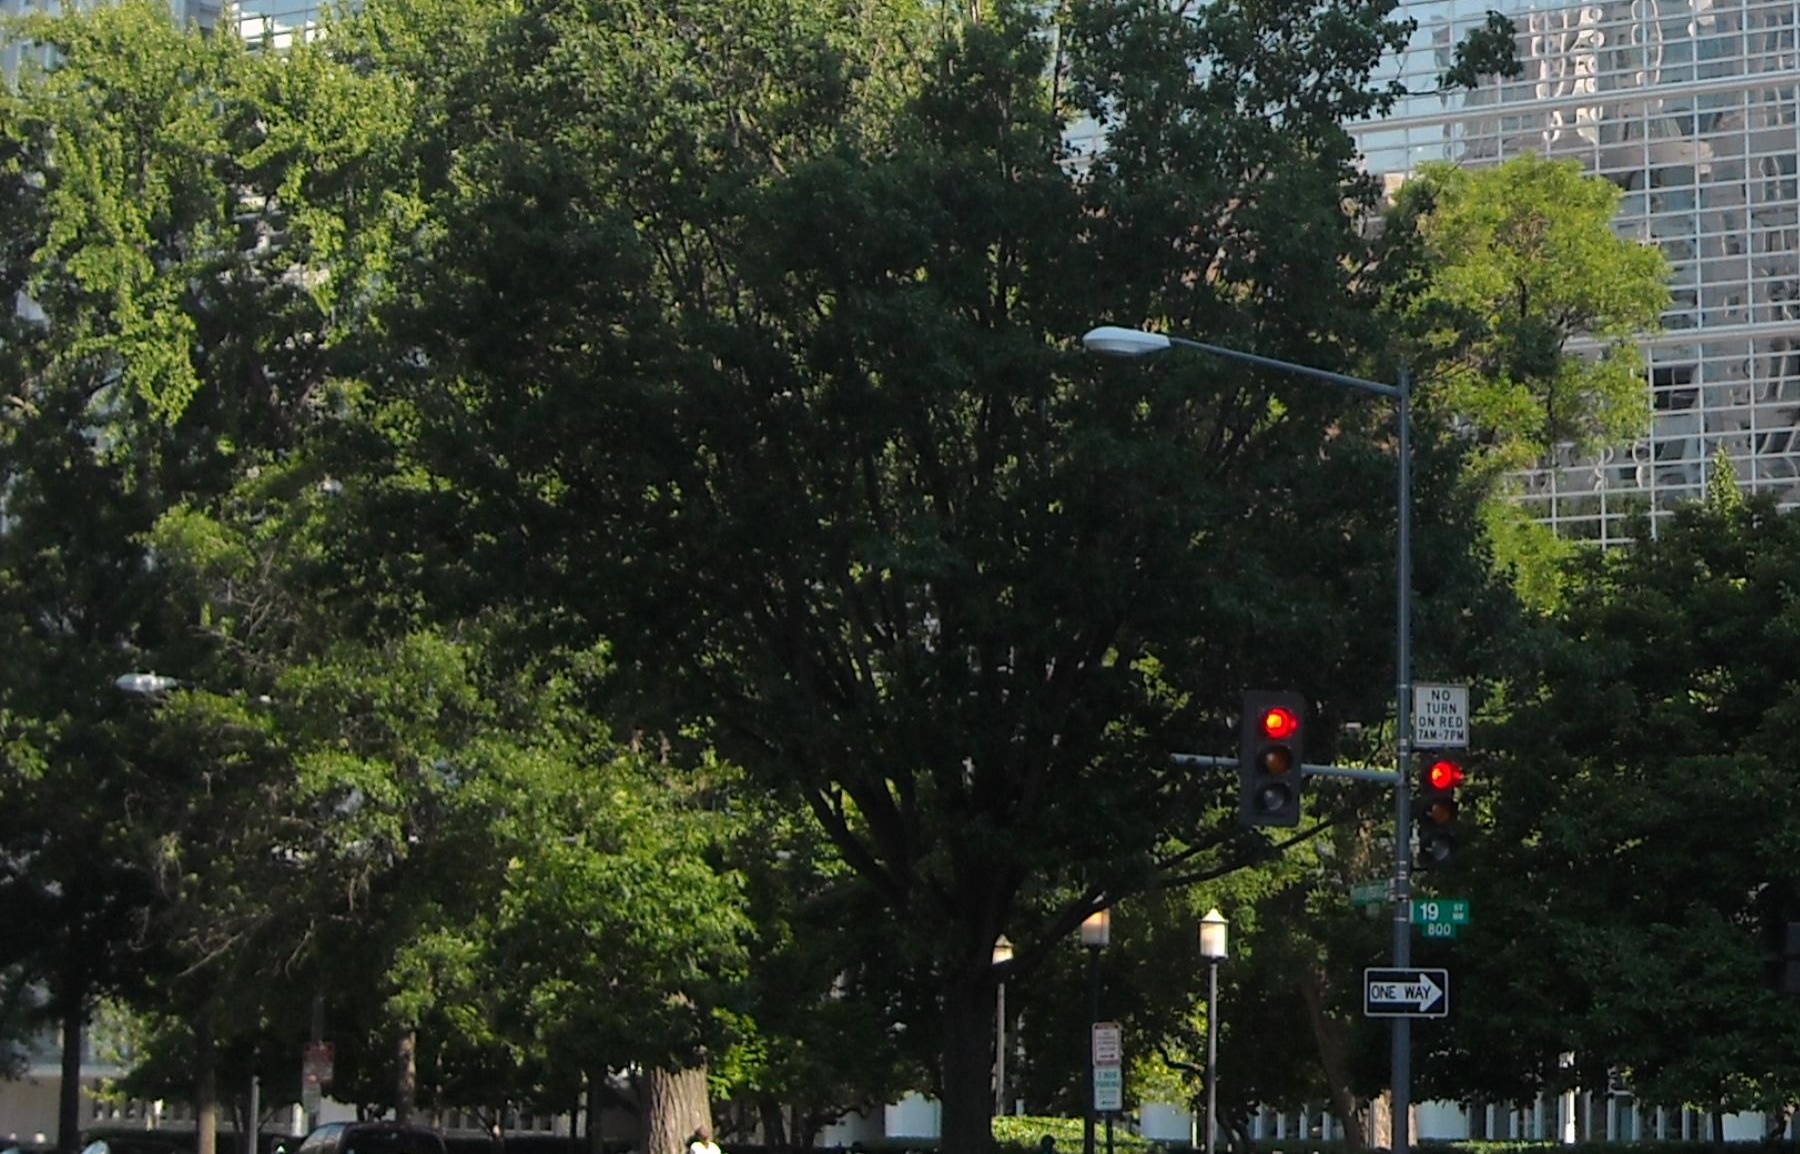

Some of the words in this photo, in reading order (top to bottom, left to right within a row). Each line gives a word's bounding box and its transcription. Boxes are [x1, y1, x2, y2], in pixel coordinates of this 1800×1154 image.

[1431, 689, 1451, 701] NO
[1426, 702, 1457, 714] TURN
[1418, 716, 1435, 727] ON
[1439, 716, 1463, 728] RED
[1418, 729, 1464, 741] 7AM-7PM
[1419, 902, 1440, 921] 19
[1427, 923, 1451, 936] 800
[1370, 984, 1396, 999] ONE
[1404, 985, 1431, 999] WAY
